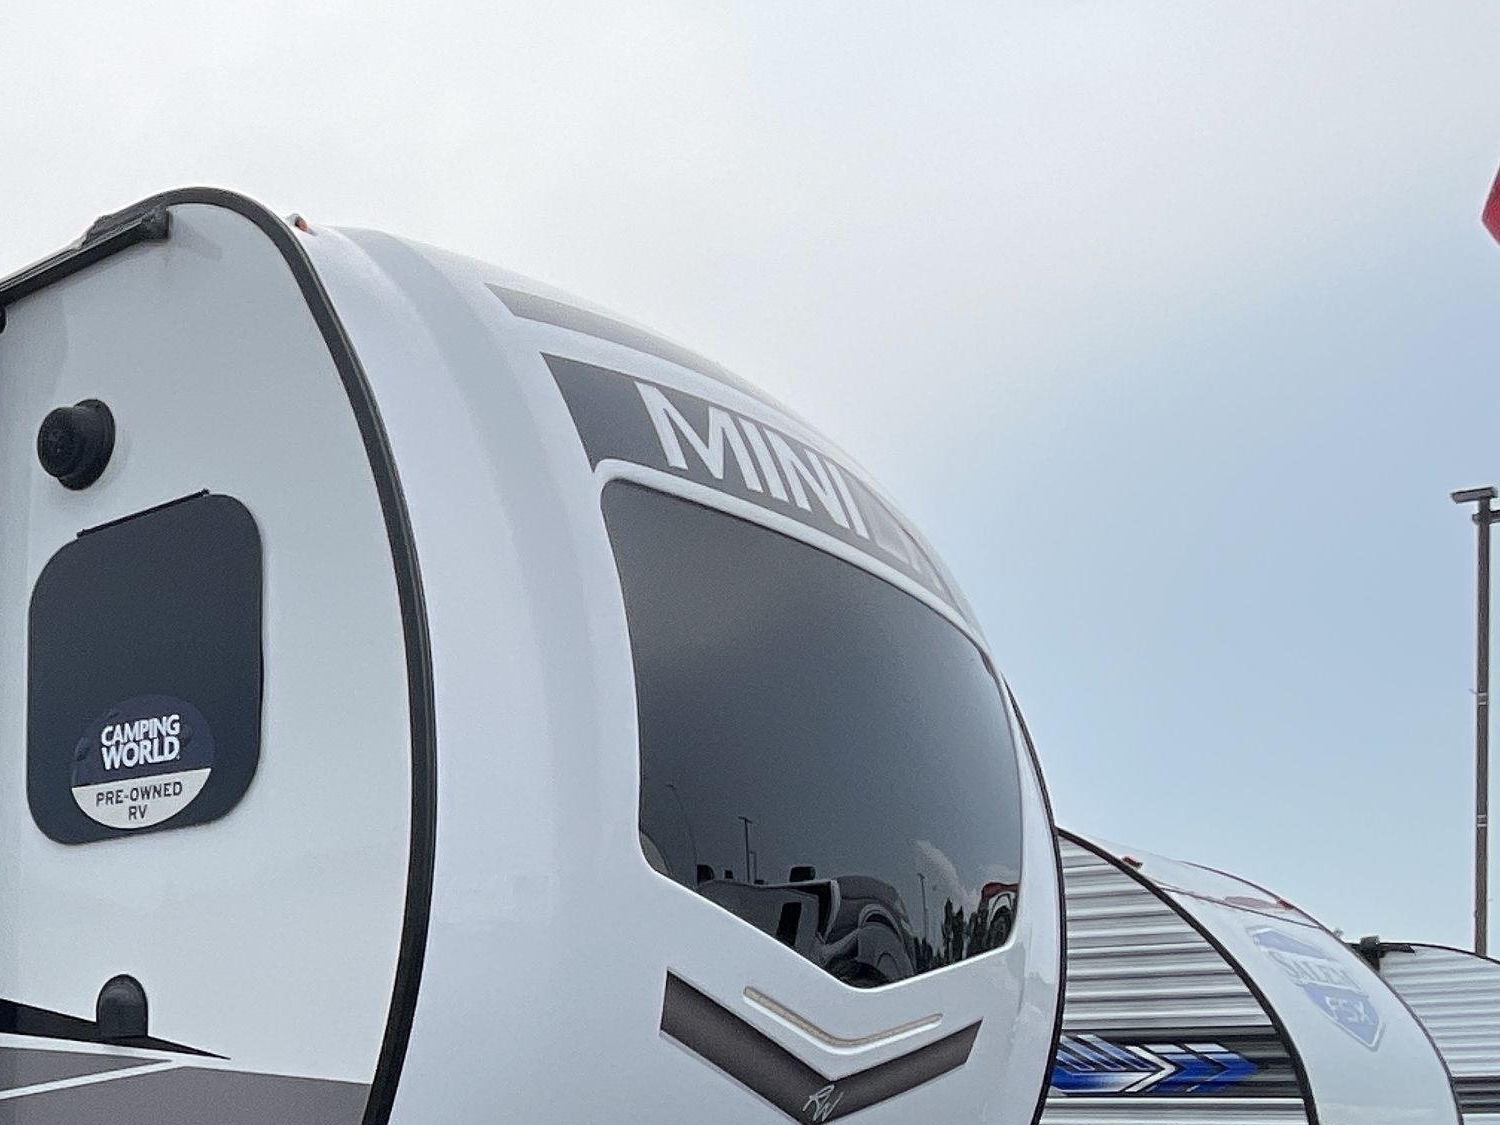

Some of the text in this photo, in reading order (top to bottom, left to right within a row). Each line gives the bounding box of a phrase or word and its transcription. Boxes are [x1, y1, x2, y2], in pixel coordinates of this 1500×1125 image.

[101, 714, 181, 746] CAMPING
[101, 736, 181, 770] WORLD
[95, 781, 183, 806] PRE-OWNED
[128, 804, 149, 821] RV
